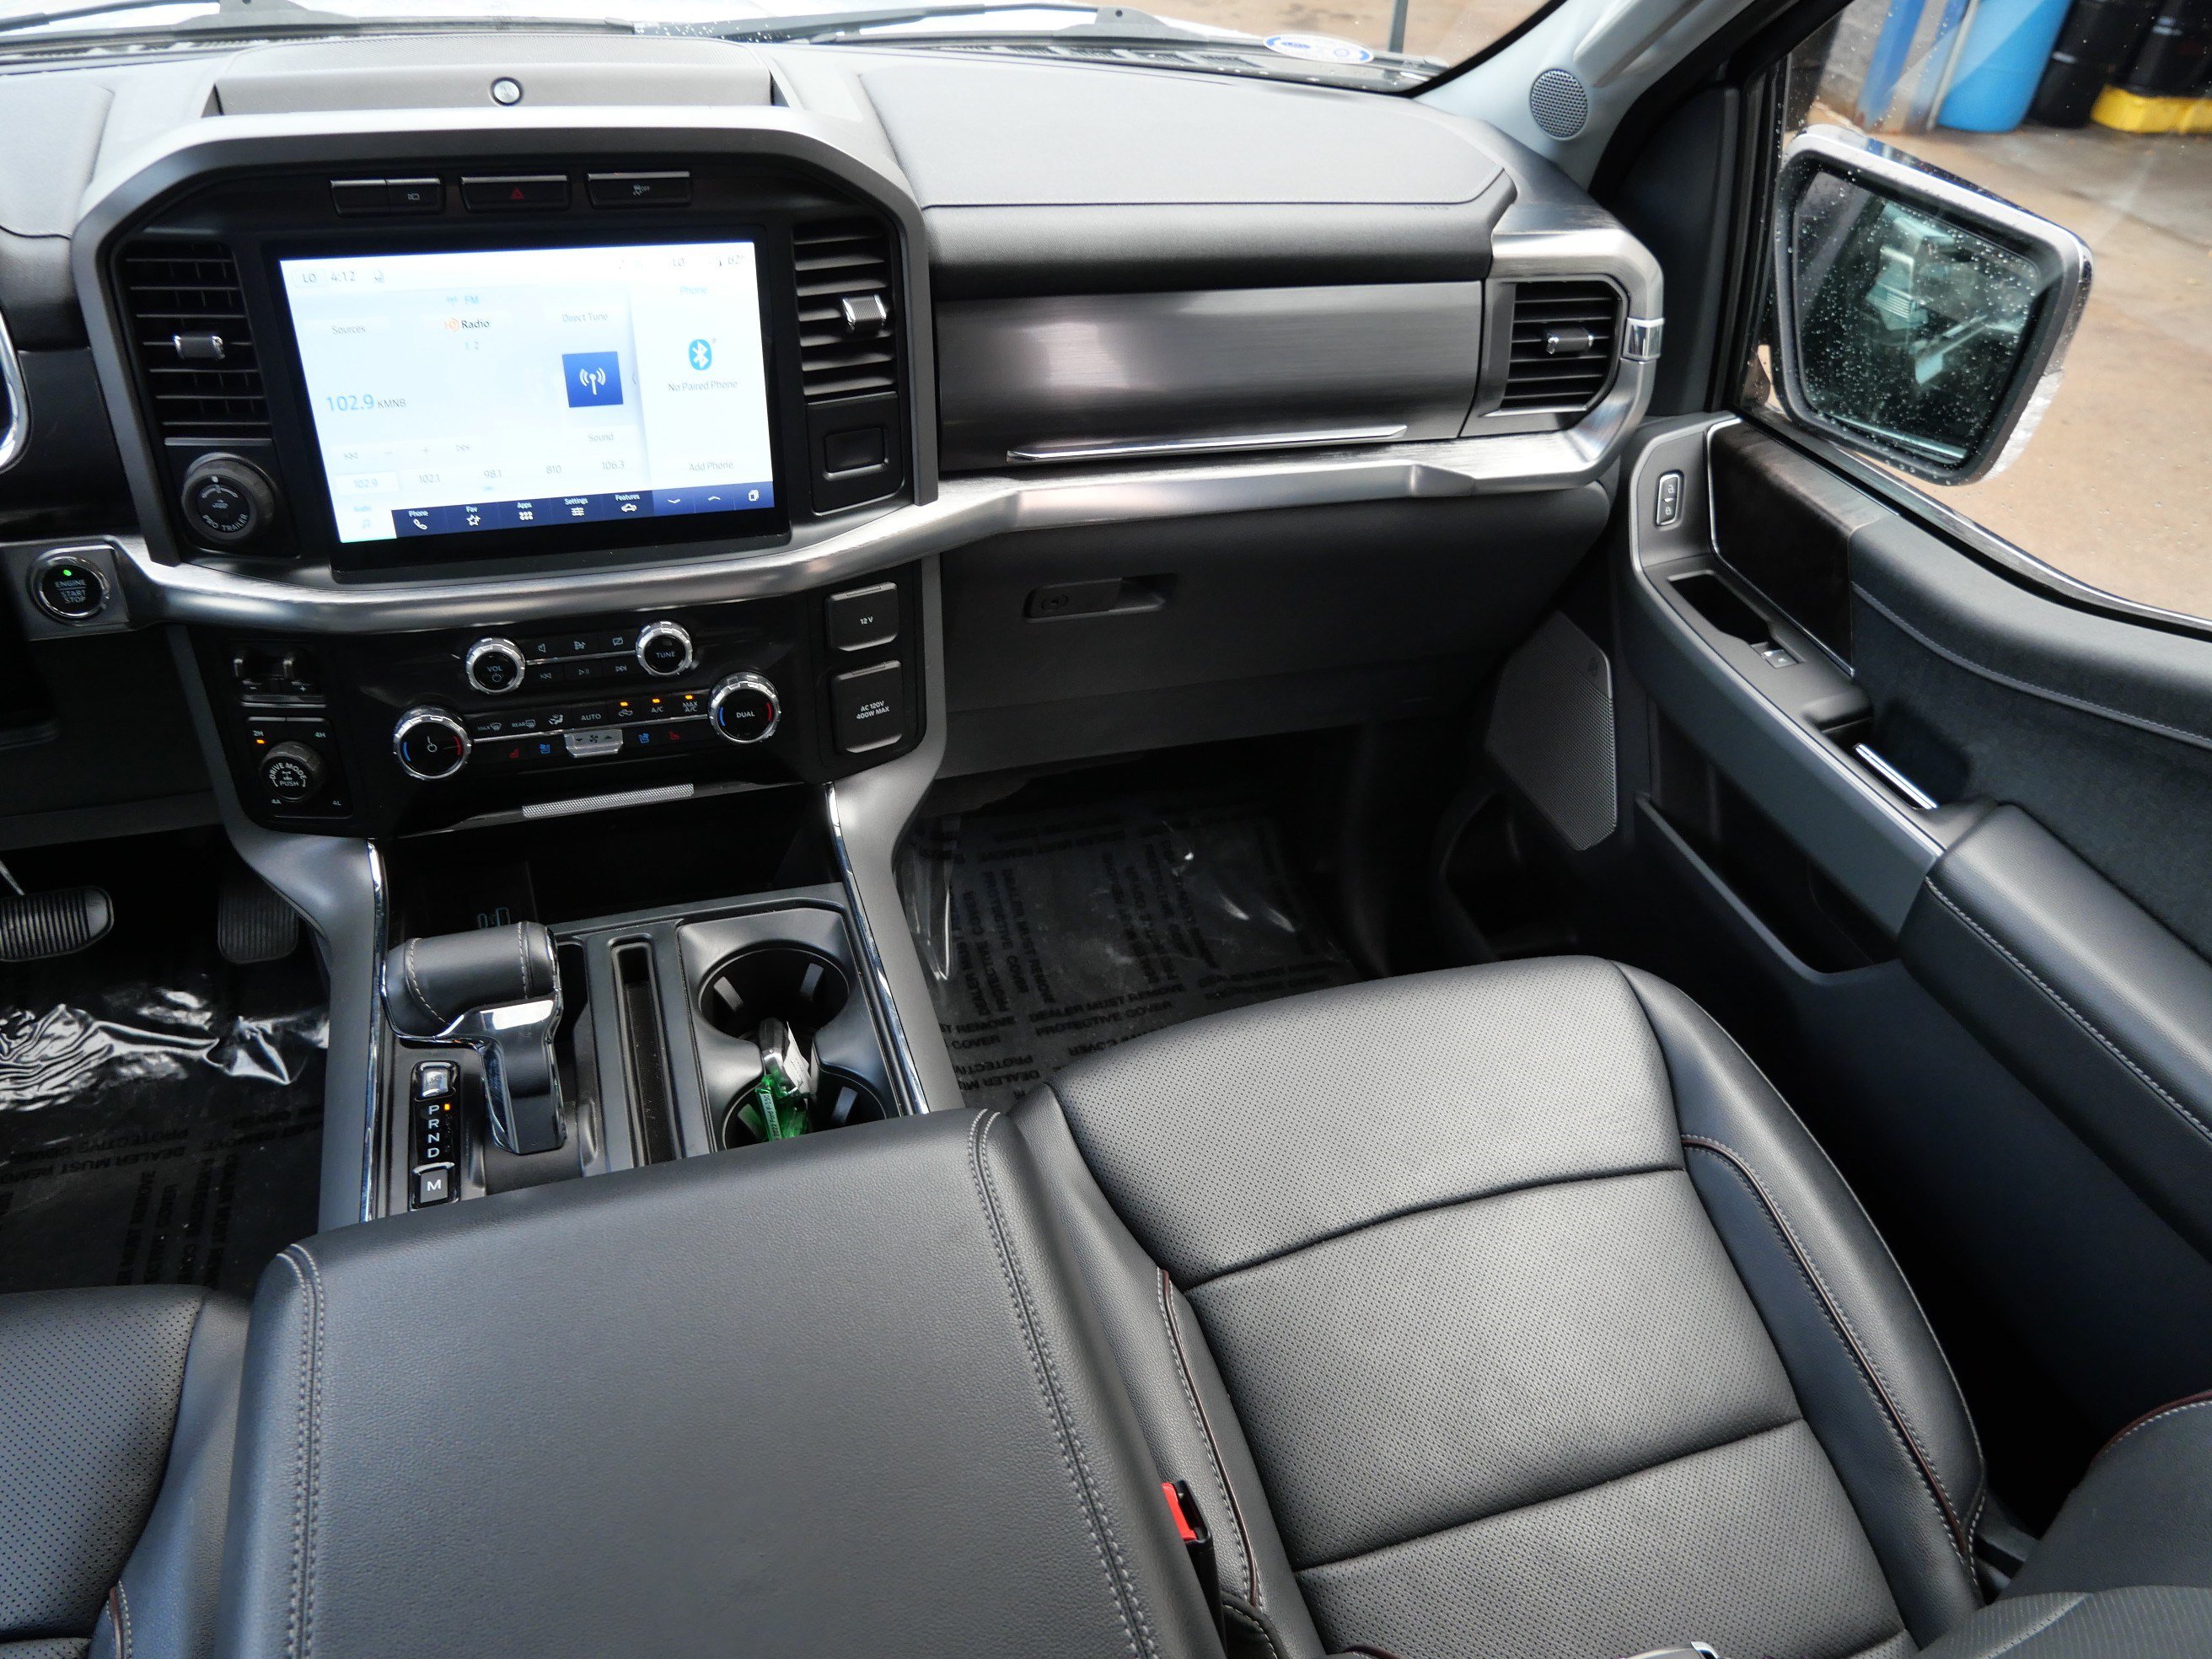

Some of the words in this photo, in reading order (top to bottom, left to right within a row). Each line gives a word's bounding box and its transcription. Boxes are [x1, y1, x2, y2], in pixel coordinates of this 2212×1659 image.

[302, 272, 317, 283] LO
[330, 271, 357, 283] 4:12
[679, 286, 709, 296] Phone
[464, 295, 481, 304] FM
[561, 313, 586, 323] Direct
[588, 312, 609, 322] Tune
[331, 323, 366, 335] Sources
[460, 319, 491, 330] Radio
[667, 383, 681, 392] No
[682, 381, 709, 391] Paired
[710, 379, 738, 390] Phone
[325, 394, 375, 412] 102.9
[377, 398, 406, 410] KMNB
[588, 432, 614, 443] Sound
[689, 462, 706, 472] Add
[706, 460, 733, 471] Phone
[353, 478, 379, 489] 102.9
[418, 473, 441, 484] 102.1
[483, 469, 502, 480] 98.1
[546, 464, 562, 475] 810
[602, 460, 625, 470] 106.3
[564, 496, 588, 506] Settings
[615, 493, 640, 502] Features
[465, 505, 478, 513] Fav
[517, 502, 532, 510] Apps
[202, 514, 218, 529] PRO
[221, 513, 249, 532] TRAILER
[54, 579, 87, 588] ENGINE
[61, 589, 86, 598] START
[64, 596, 87, 604] STOP
[655, 651, 676, 659] TUNE
[486, 665, 504, 674] VOL
[869, 701, 884, 710] 120V
[581, 713, 602, 722] AUTO
[856, 709, 876, 719] 400W
[875, 706, 890, 716] MAX
[269, 762, 285, 780] DRIVE
[285, 762, 308, 780] MODE
[1029, 1003, 1082, 1023] DEALER
[1085, 996, 1124, 1013] MUST
[1128, 983, 1187, 1002] REMOVE
[1035, 1013, 1121, 1037] PROTECTIVE
[1125, 1000, 1173, 1018] COVER
[956, 1016, 1016, 1034] REMOVE
[952, 1034, 1001, 1050] COVER
[1069, 1039, 1116, 1057] COVER
[953, 1055, 1034, 1075] PROTECTIV
[982, 1069, 1041, 1087] DEALER
[428, 1104, 440, 1115] P
[427, 1119, 440, 1130] R
[427, 1132, 440, 1144] N
[115, 1146, 185, 1167] DEALER
[427, 1147, 440, 1158] D
[61, 1157, 110, 1174] MUST
[427, 1178, 442, 1191] M
